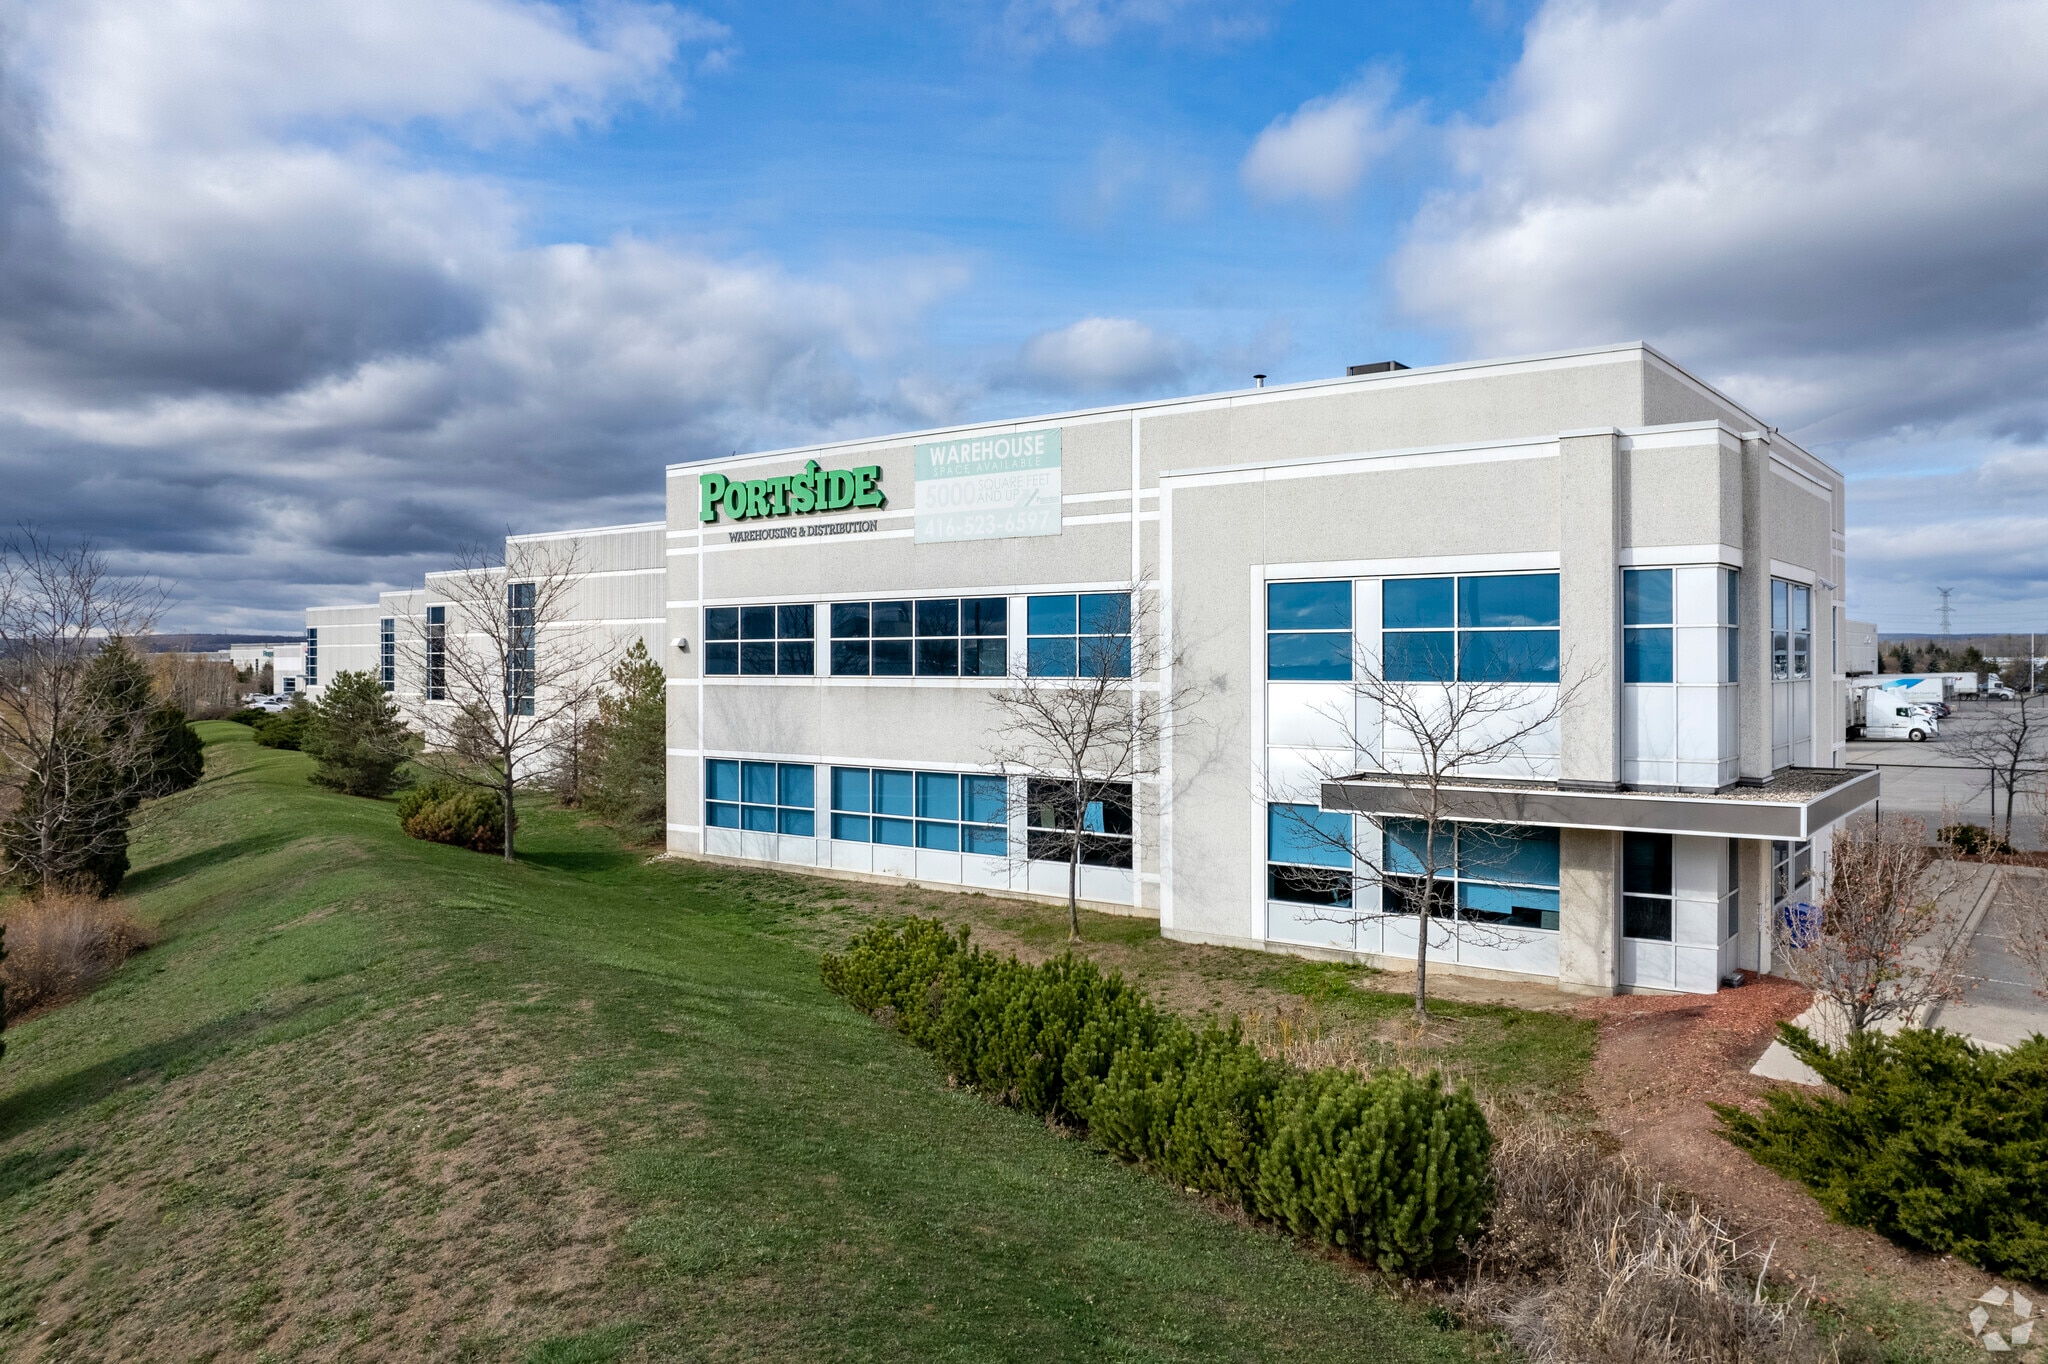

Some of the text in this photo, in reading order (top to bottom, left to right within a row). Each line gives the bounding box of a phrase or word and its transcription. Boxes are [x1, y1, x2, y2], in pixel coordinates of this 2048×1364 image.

[930, 436, 1044, 465] WAREHOUSE
[933, 456, 1040, 477] SPACE AVAILABLE
[977, 472, 1050, 491] SQUARE FEET
[926, 481, 976, 508] 5000
[977, 490, 1002, 505] AND
[1005, 489, 1020, 502] UP
[729, 520, 878, 543] WAREHOUSING & DISTRIBUTION
[924, 510, 1051, 538] 416-523-6597
